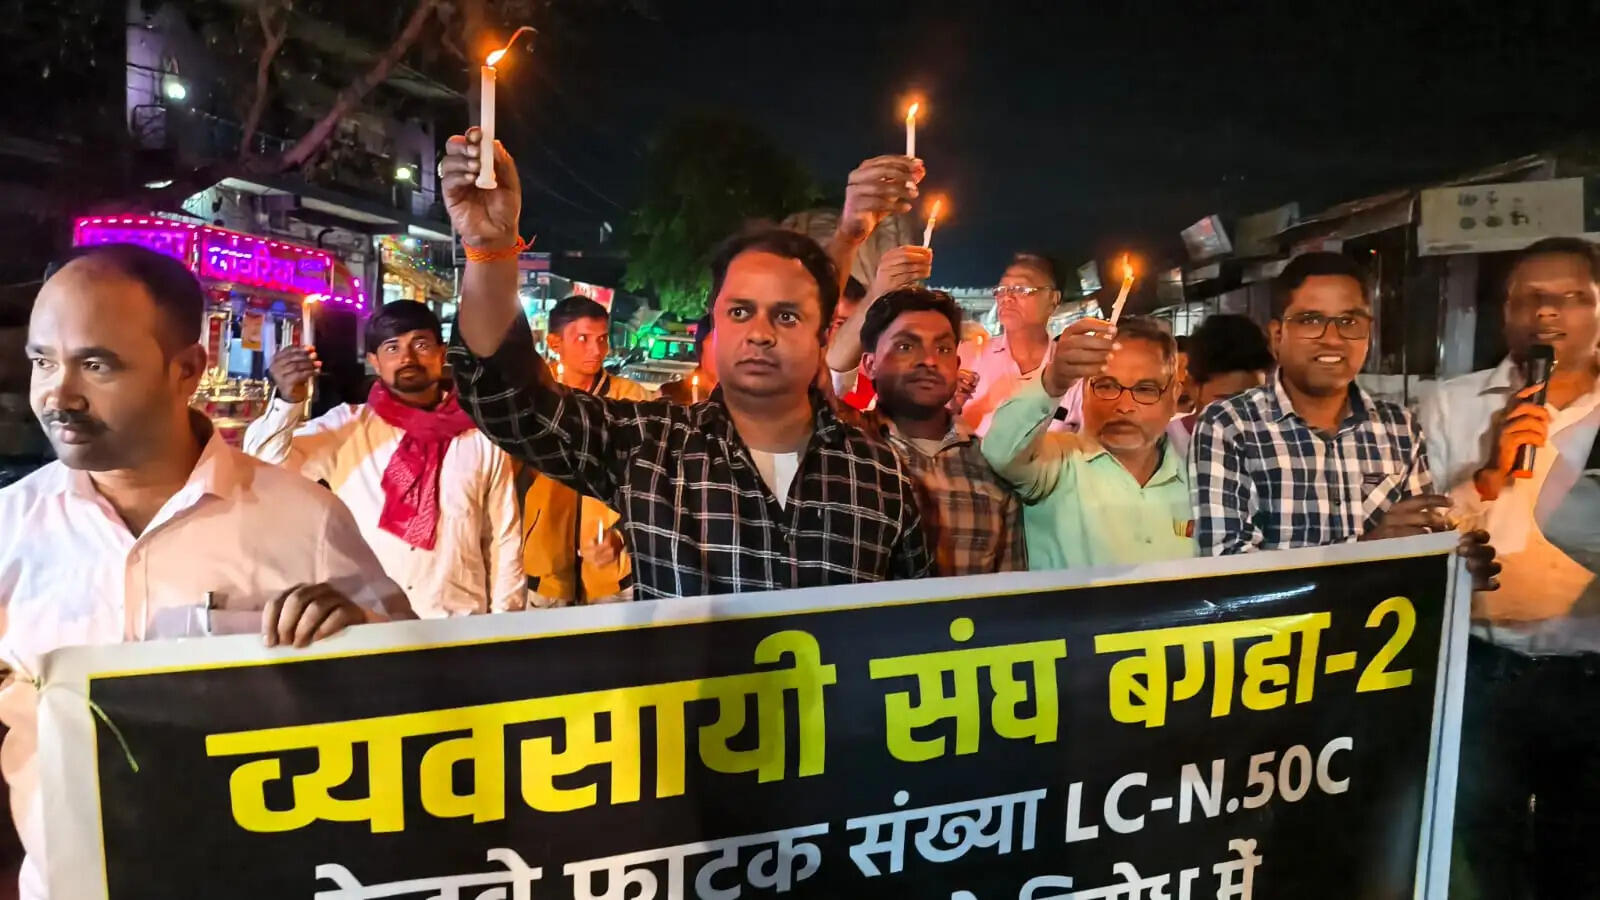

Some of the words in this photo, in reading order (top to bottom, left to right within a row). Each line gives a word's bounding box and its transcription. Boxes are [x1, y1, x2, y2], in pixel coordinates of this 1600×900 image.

[206, 630, 836, 833] व्यवसायी
[869, 617, 1067, 762] संघ
[1094, 596, 1417, 728] बगहा-2
[563, 822, 830, 900] फाटक
[846, 788, 1048, 877] संख्या
[1065, 737, 1354, 843] LC-N.50C
